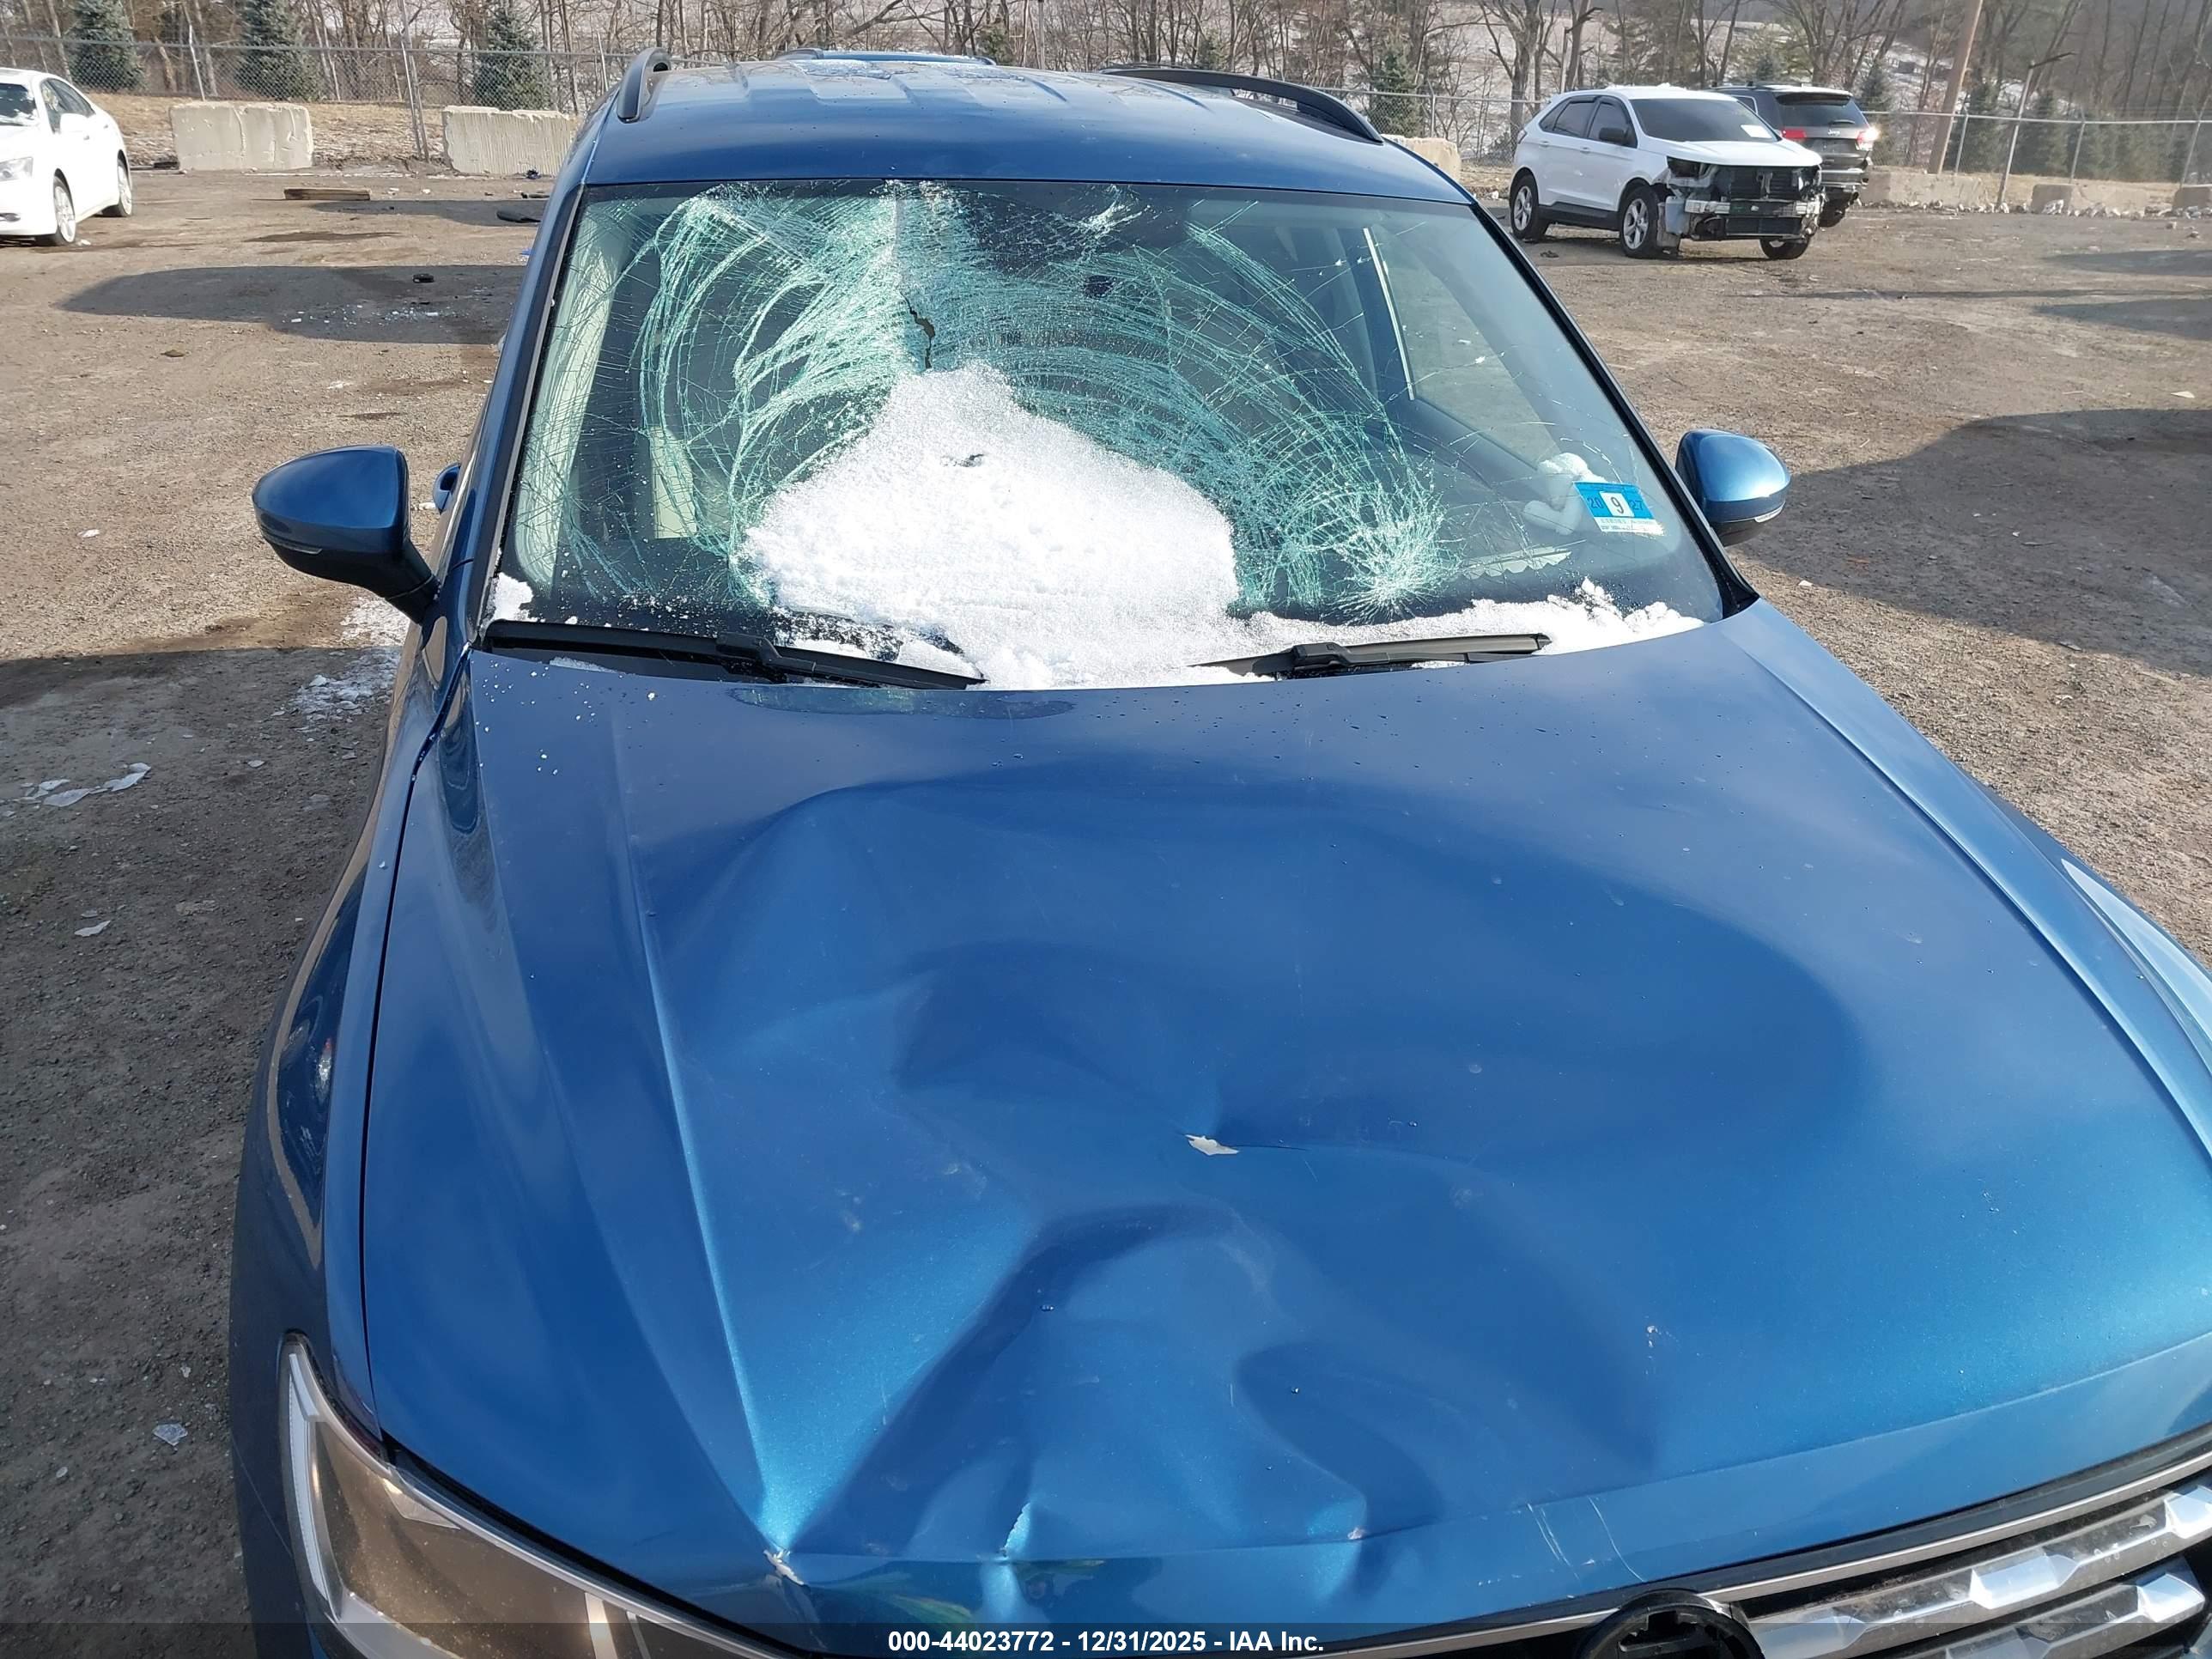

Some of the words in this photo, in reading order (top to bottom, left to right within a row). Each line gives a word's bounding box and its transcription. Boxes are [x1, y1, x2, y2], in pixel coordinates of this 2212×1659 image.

[1587, 497, 1604, 508] 20
[1610, 496, 1625, 514] 9
[1629, 501, 1644, 511] 27
